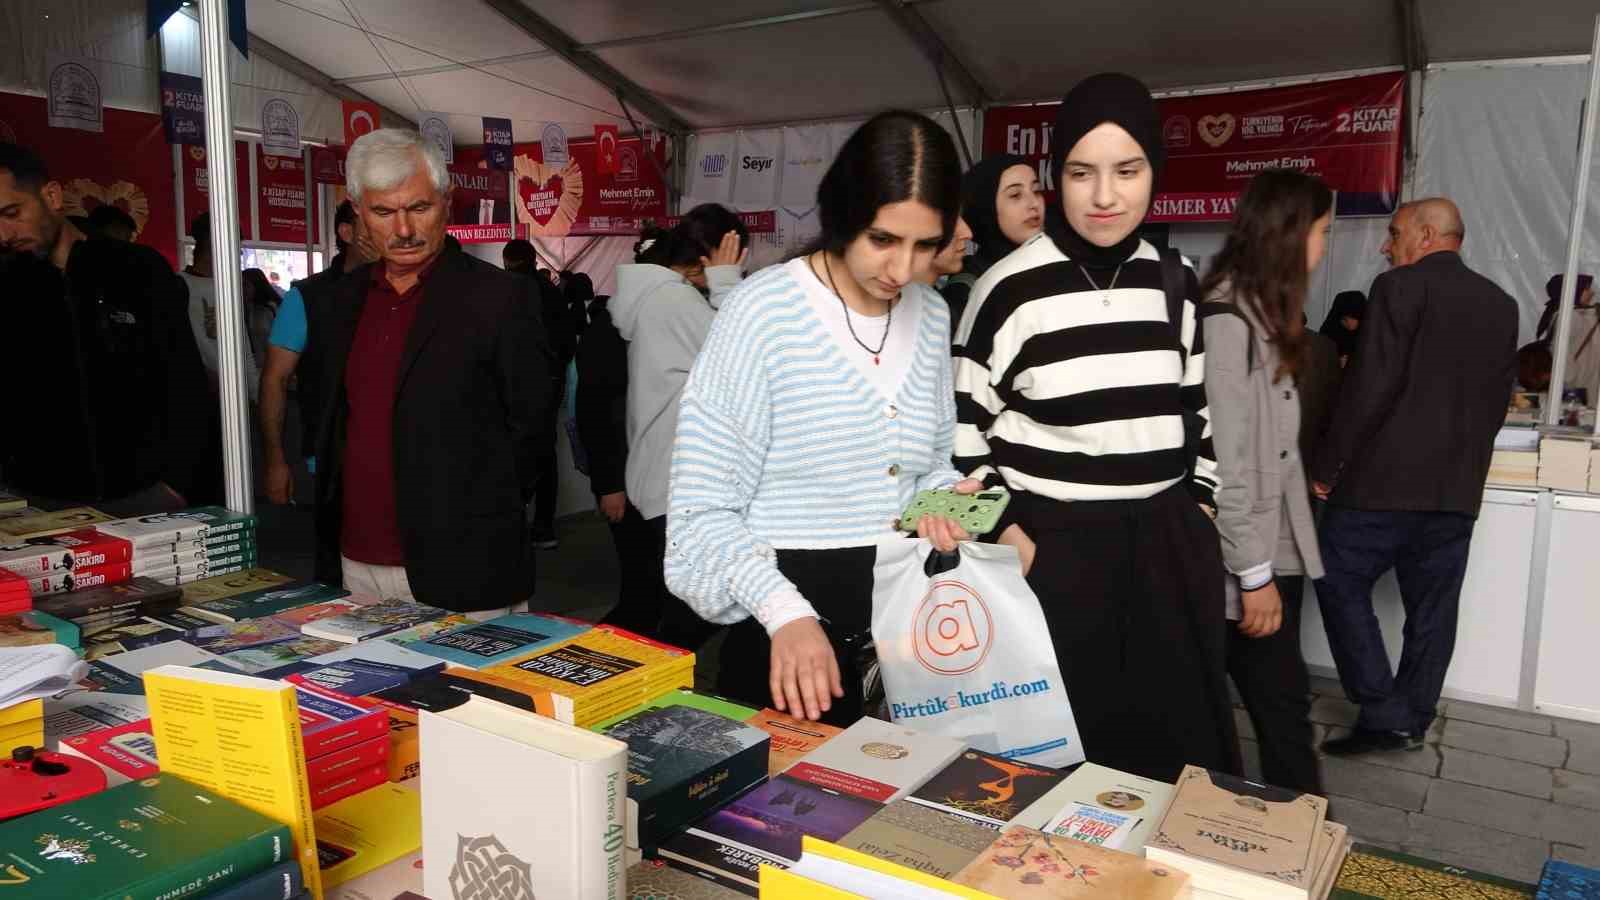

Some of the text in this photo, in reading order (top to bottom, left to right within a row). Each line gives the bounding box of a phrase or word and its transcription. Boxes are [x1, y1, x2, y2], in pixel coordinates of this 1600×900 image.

[1007, 124, 1036, 155] En
[1226, 155, 1316, 173] Mehmet Emin
[599, 186, 655, 199] Mehmet Emin
[603, 823, 624, 852] 40
